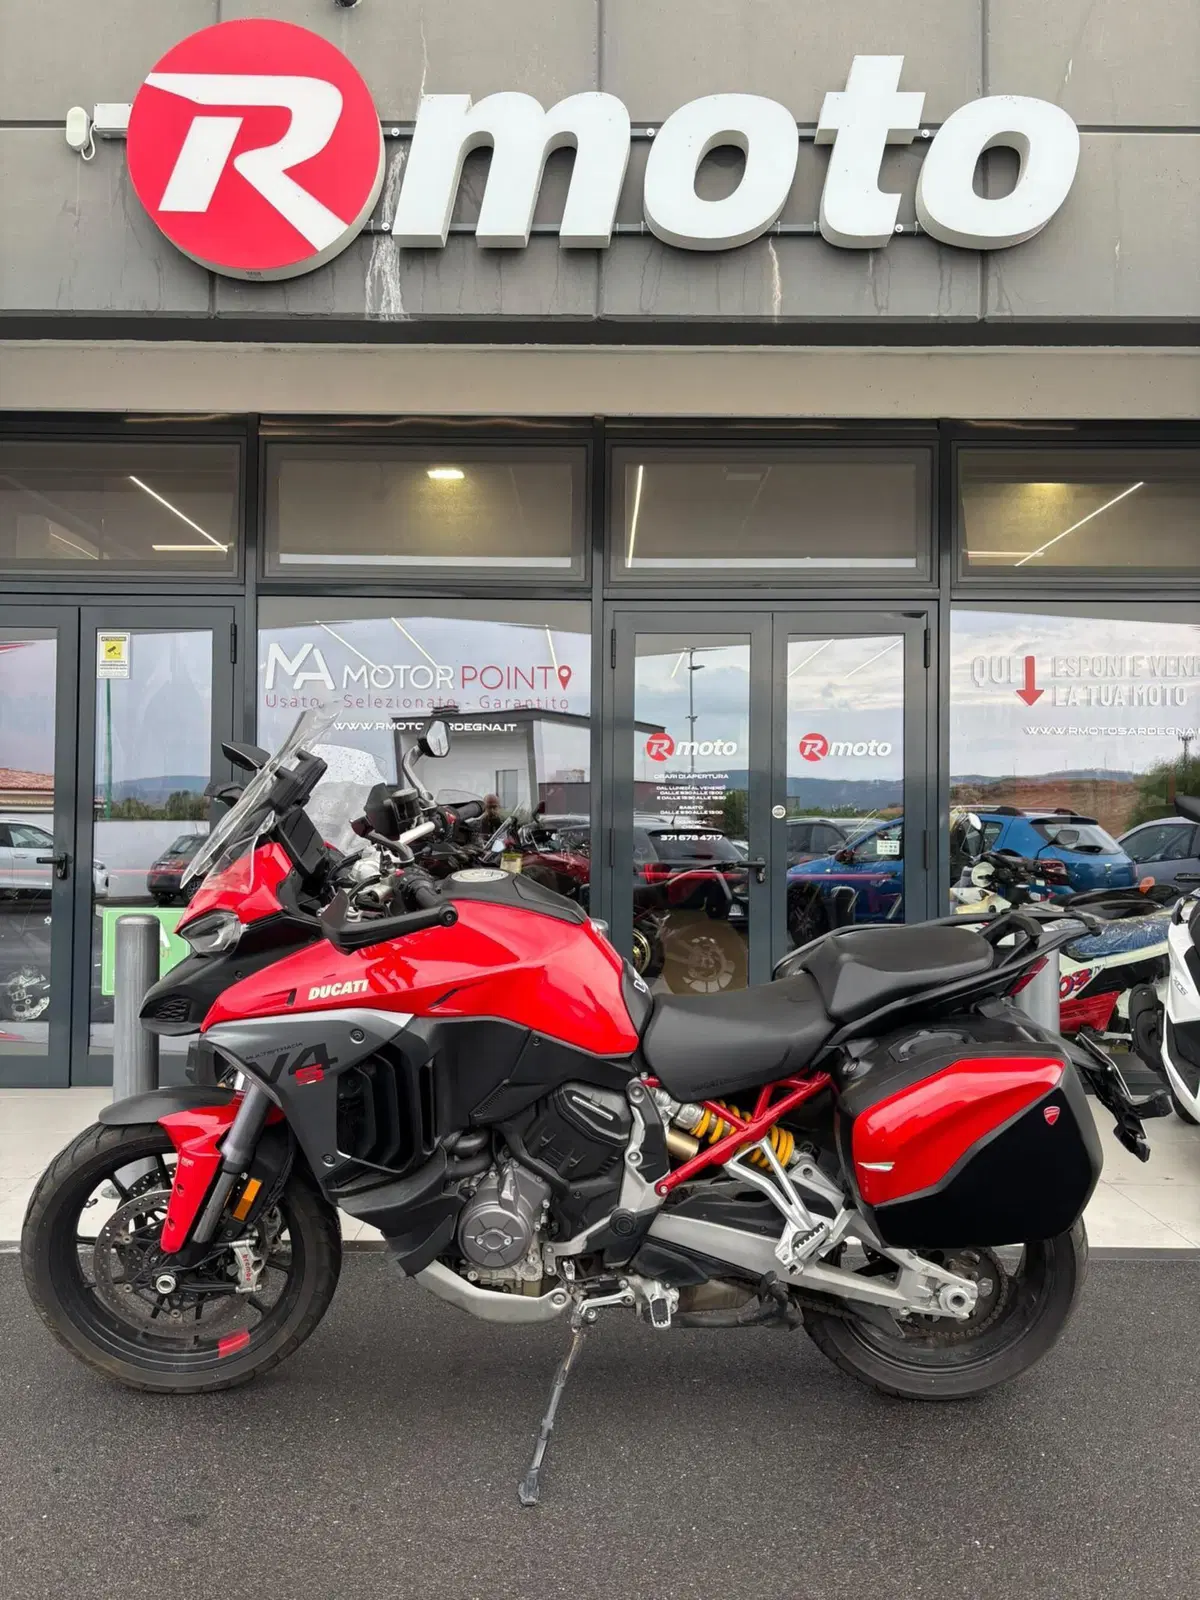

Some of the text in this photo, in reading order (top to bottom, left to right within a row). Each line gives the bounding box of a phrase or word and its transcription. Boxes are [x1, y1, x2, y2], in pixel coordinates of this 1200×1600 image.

[392, 54, 1081, 251] moto
[342, 666, 553, 690] MOTOR POINT
[972, 656, 1017, 687] QUI
[265, 694, 319, 709] Usato
[343, 694, 456, 709] Selezionato
[479, 695, 568, 710] Garantito
[1052, 686, 1188, 706] LA TUA MOTO
[333, 721, 518, 733] WWW.RMOTORDEGNA.IT
[676, 739, 738, 757] moto
[828, 739, 892, 757] moto
[308, 979, 368, 1000] DUCATI
[242, 1254, 251, 1281] brembo
